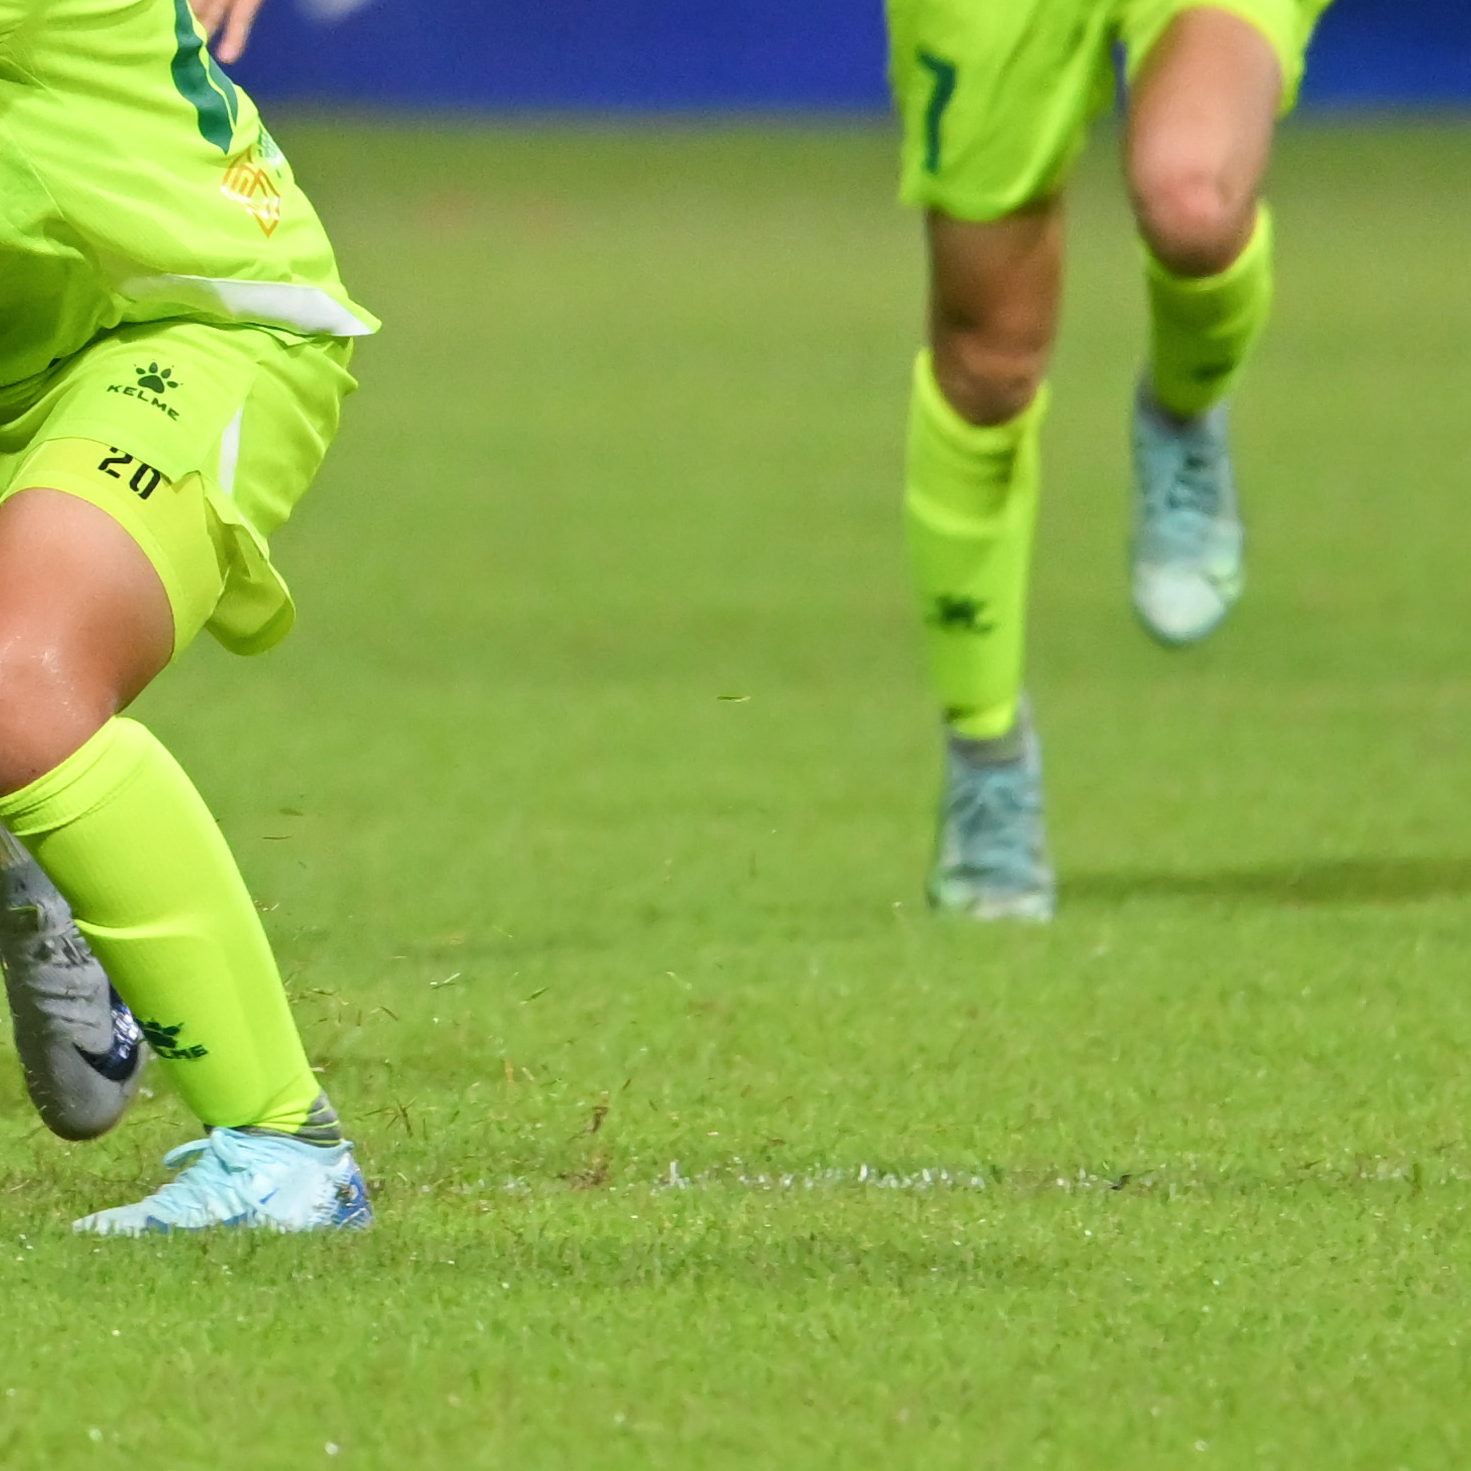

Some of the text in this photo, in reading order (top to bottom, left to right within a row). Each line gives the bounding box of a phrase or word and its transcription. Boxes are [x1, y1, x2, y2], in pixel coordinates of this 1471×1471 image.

[915, 44, 958, 174] 7
[106, 384, 181, 422] KELME
[97, 446, 162, 501] 20
